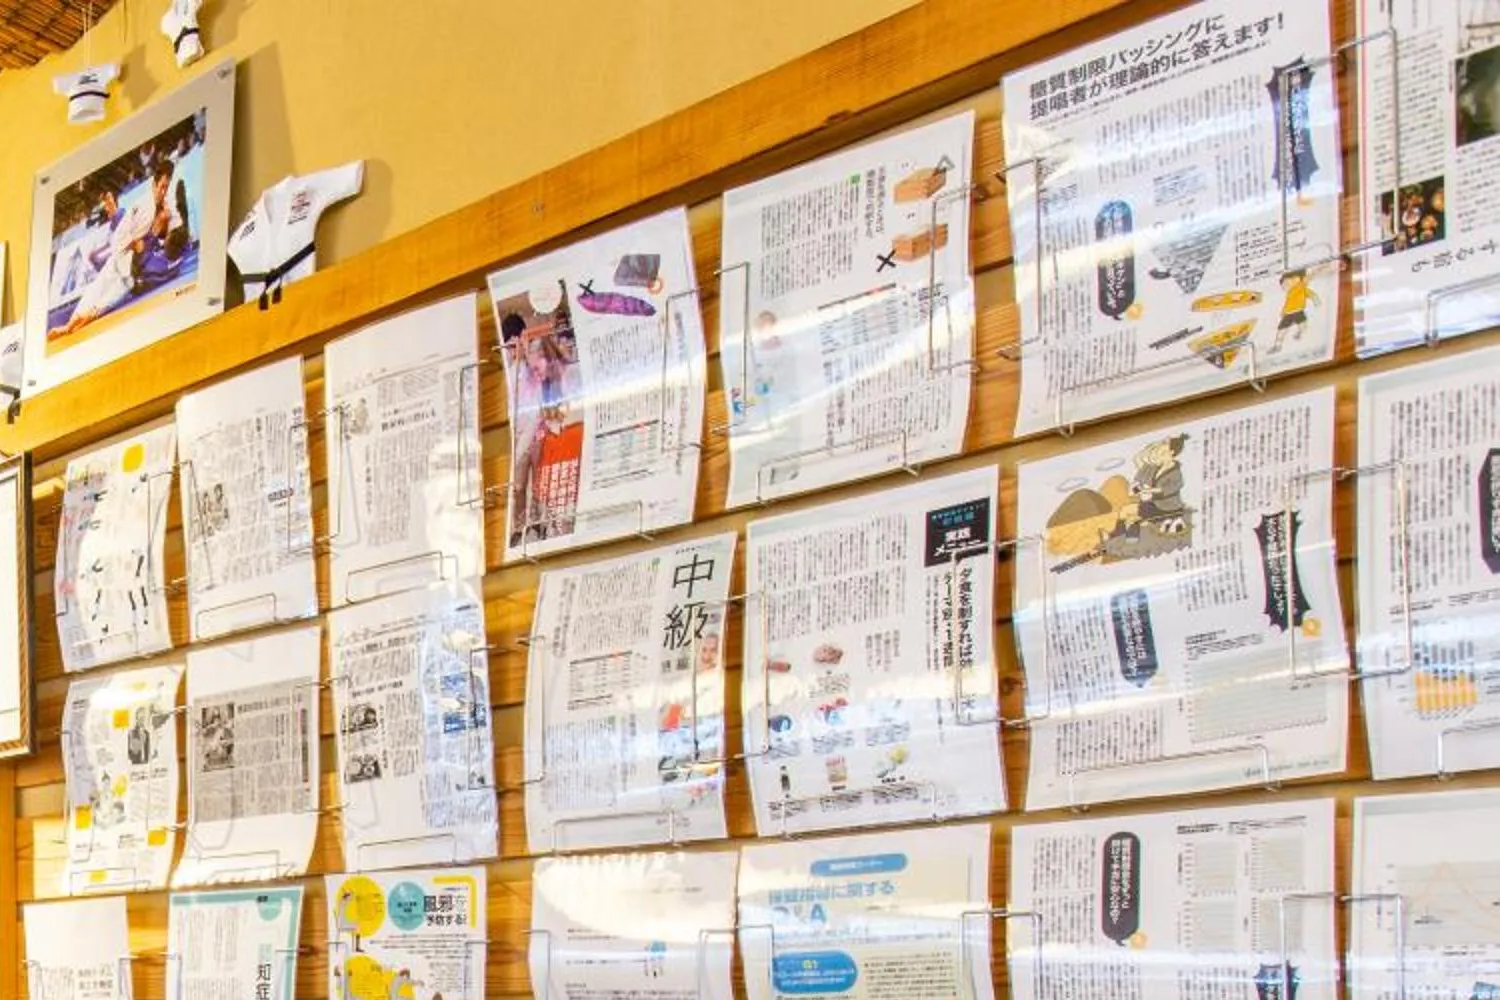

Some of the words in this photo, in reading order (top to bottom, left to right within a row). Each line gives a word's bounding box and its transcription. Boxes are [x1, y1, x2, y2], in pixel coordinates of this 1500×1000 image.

[1030, 14, 1226, 100] 糖質制限バッシングに
[663, 553, 714, 651] 中級
